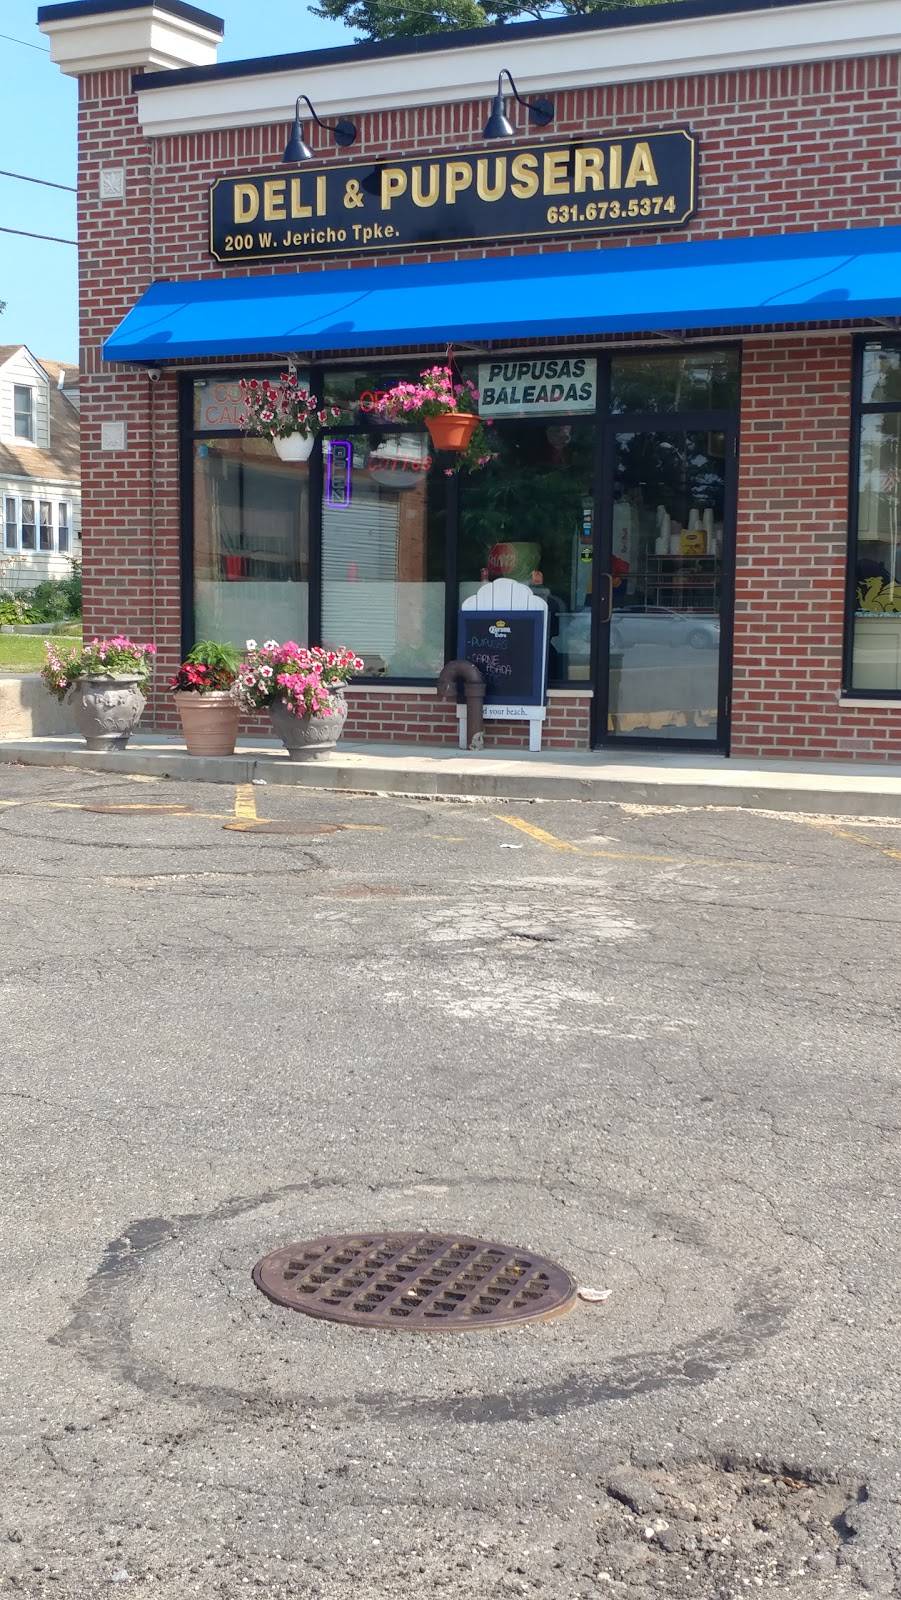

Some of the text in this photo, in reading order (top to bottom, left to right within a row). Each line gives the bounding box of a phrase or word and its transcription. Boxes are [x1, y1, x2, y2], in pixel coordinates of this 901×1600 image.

[233, 141, 659, 225] DELI & PUPUSERIA
[546, 196, 677, 225] 631.673.5374
[224, 223, 401, 252] 200 W. Jericho Tpke.
[488, 359, 587, 383] PUPUSAS
[481, 382, 593, 406] BALEADAS
